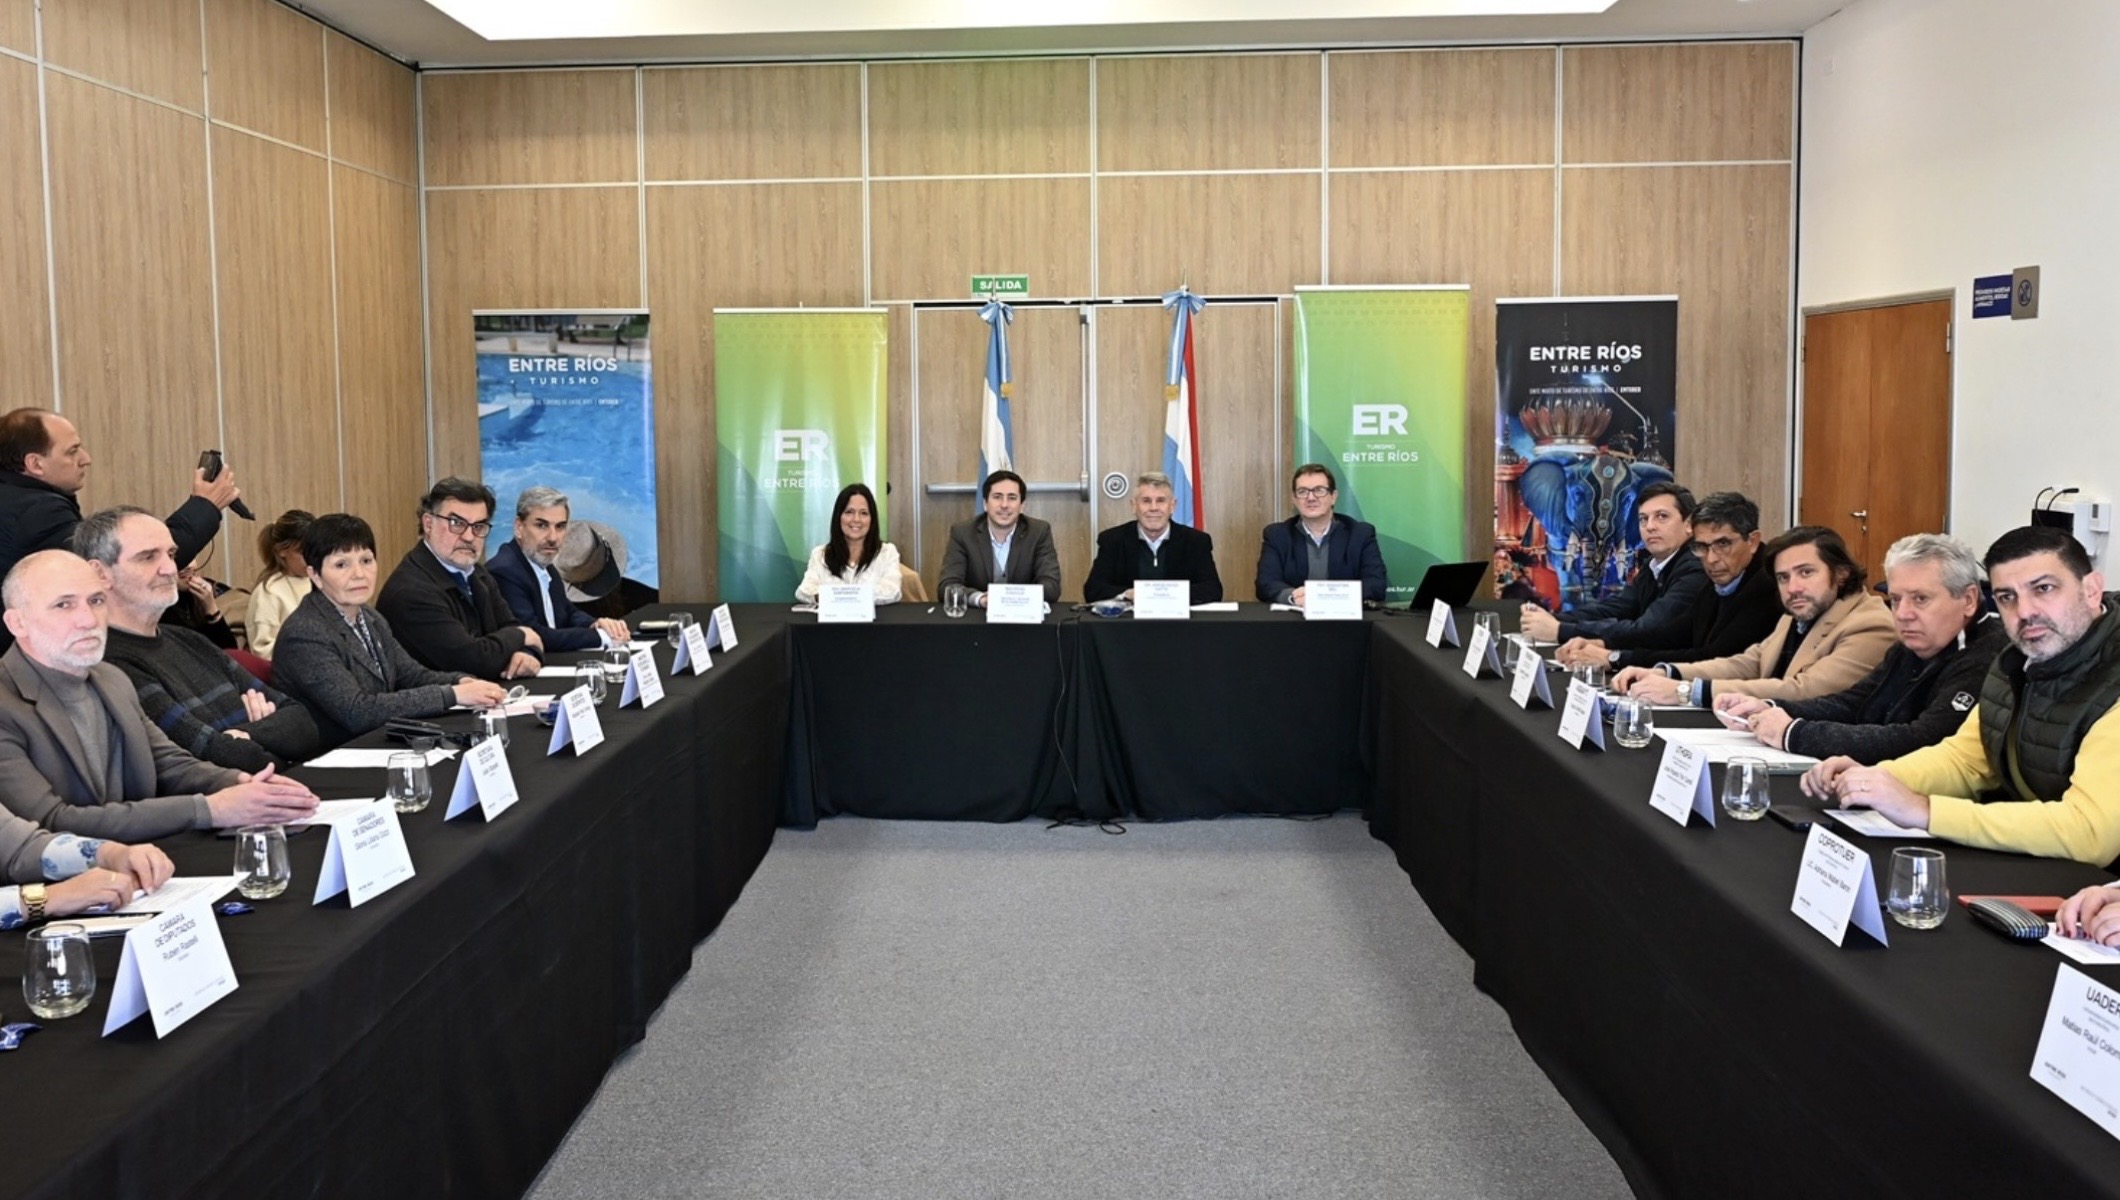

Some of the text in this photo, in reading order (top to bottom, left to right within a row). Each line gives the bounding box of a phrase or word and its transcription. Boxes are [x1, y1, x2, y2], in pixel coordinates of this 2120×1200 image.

[979, 280, 1022, 290] SALIDA
[1529, 341, 1642, 361] ENTRE RÍOS
[509, 354, 618, 373] ENTRE RÍOS
[1550, 364, 1622, 374] TURISMO
[529, 376, 600, 385] TURISMO
[1352, 404, 1409, 435] ER
[774, 429, 830, 461] ER
[1342, 450, 1418, 462] ENTRE RÍOS
[764, 478, 806, 488] ENTRE
[1818, 832, 1856, 862] COPROTUER
[2086, 986, 2120, 1019] UADER
